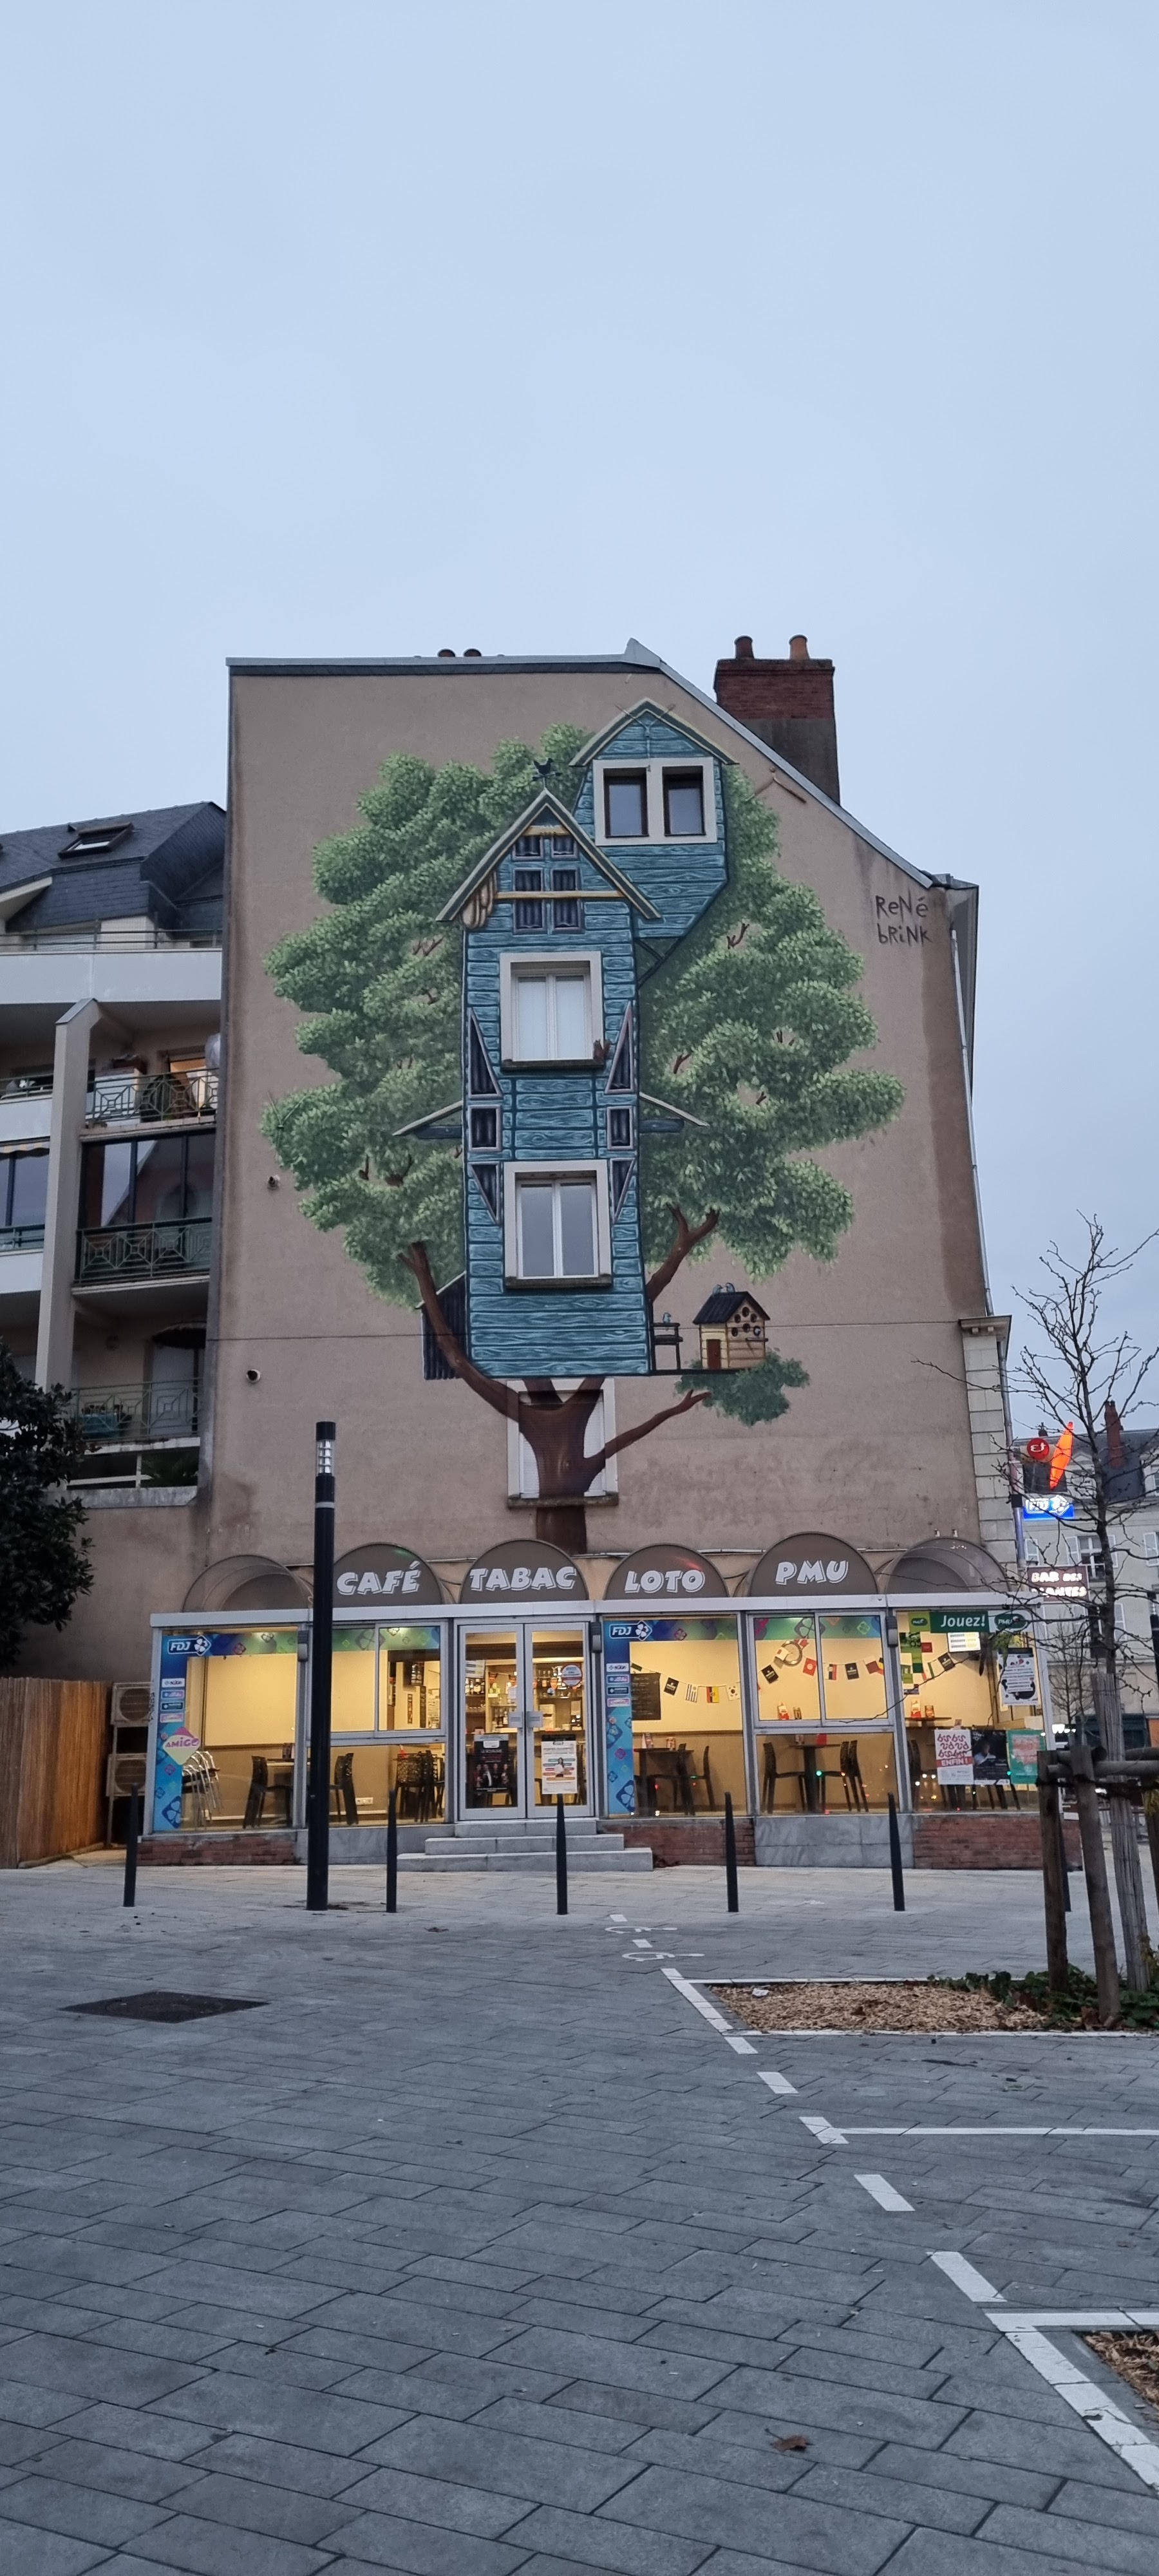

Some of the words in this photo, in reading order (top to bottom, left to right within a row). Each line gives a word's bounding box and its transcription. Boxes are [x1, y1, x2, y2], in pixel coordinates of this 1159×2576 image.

[336, 1561, 420, 1595] CAFÉ
[469, 1566, 577, 1591] TABAC
[624, 1570, 706, 1594] LOTO
[775, 1560, 849, 1586] PMU
[1031, 1571, 1060, 1582] BAR
[940, 1615, 986, 1627] Jouez!
[612, 1626, 632, 1636] FDJ
[170, 1642, 191, 1651] FDJ
